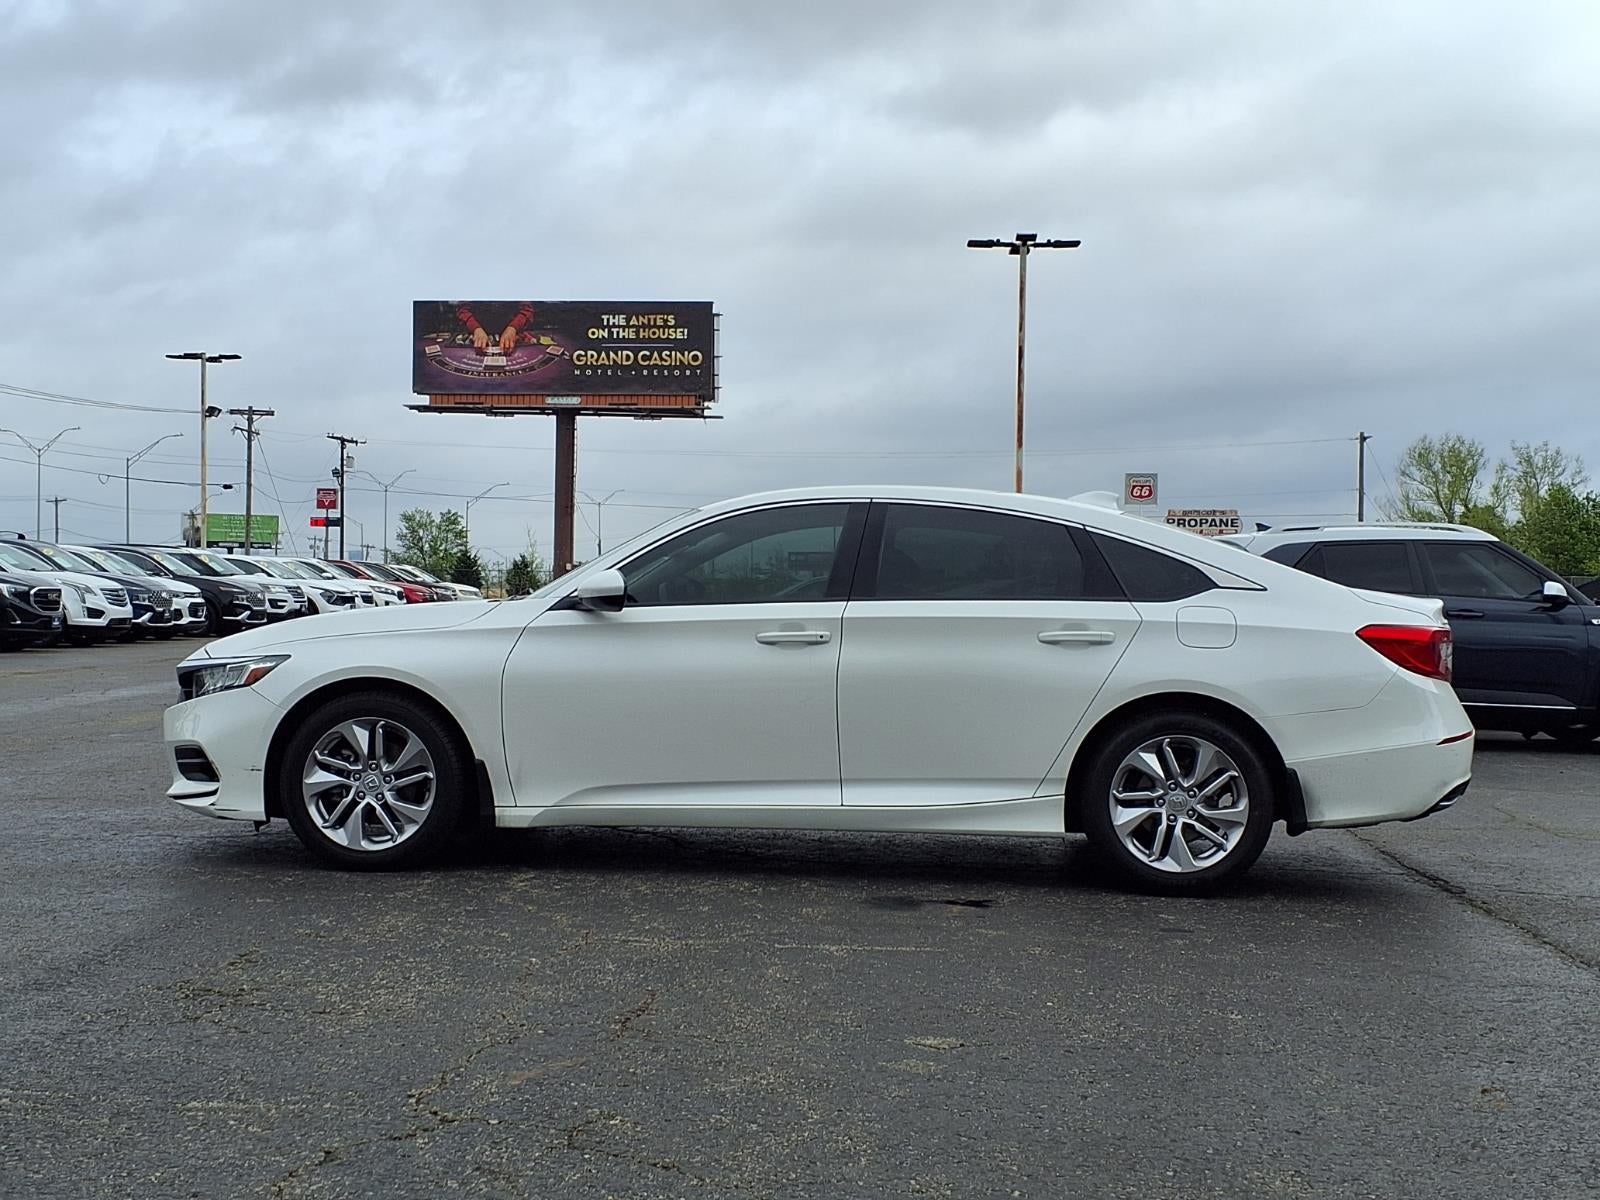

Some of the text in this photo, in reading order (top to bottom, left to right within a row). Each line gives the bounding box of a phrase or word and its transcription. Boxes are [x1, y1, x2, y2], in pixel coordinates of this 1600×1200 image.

[601, 314, 675, 326] THE ANTE'S
[588, 328, 688, 339] ON THE HOUSE!
[572, 350, 703, 366] GRAND CASINO
[1132, 486, 1150, 497] 66
[1166, 518, 1240, 528] PROPANE
